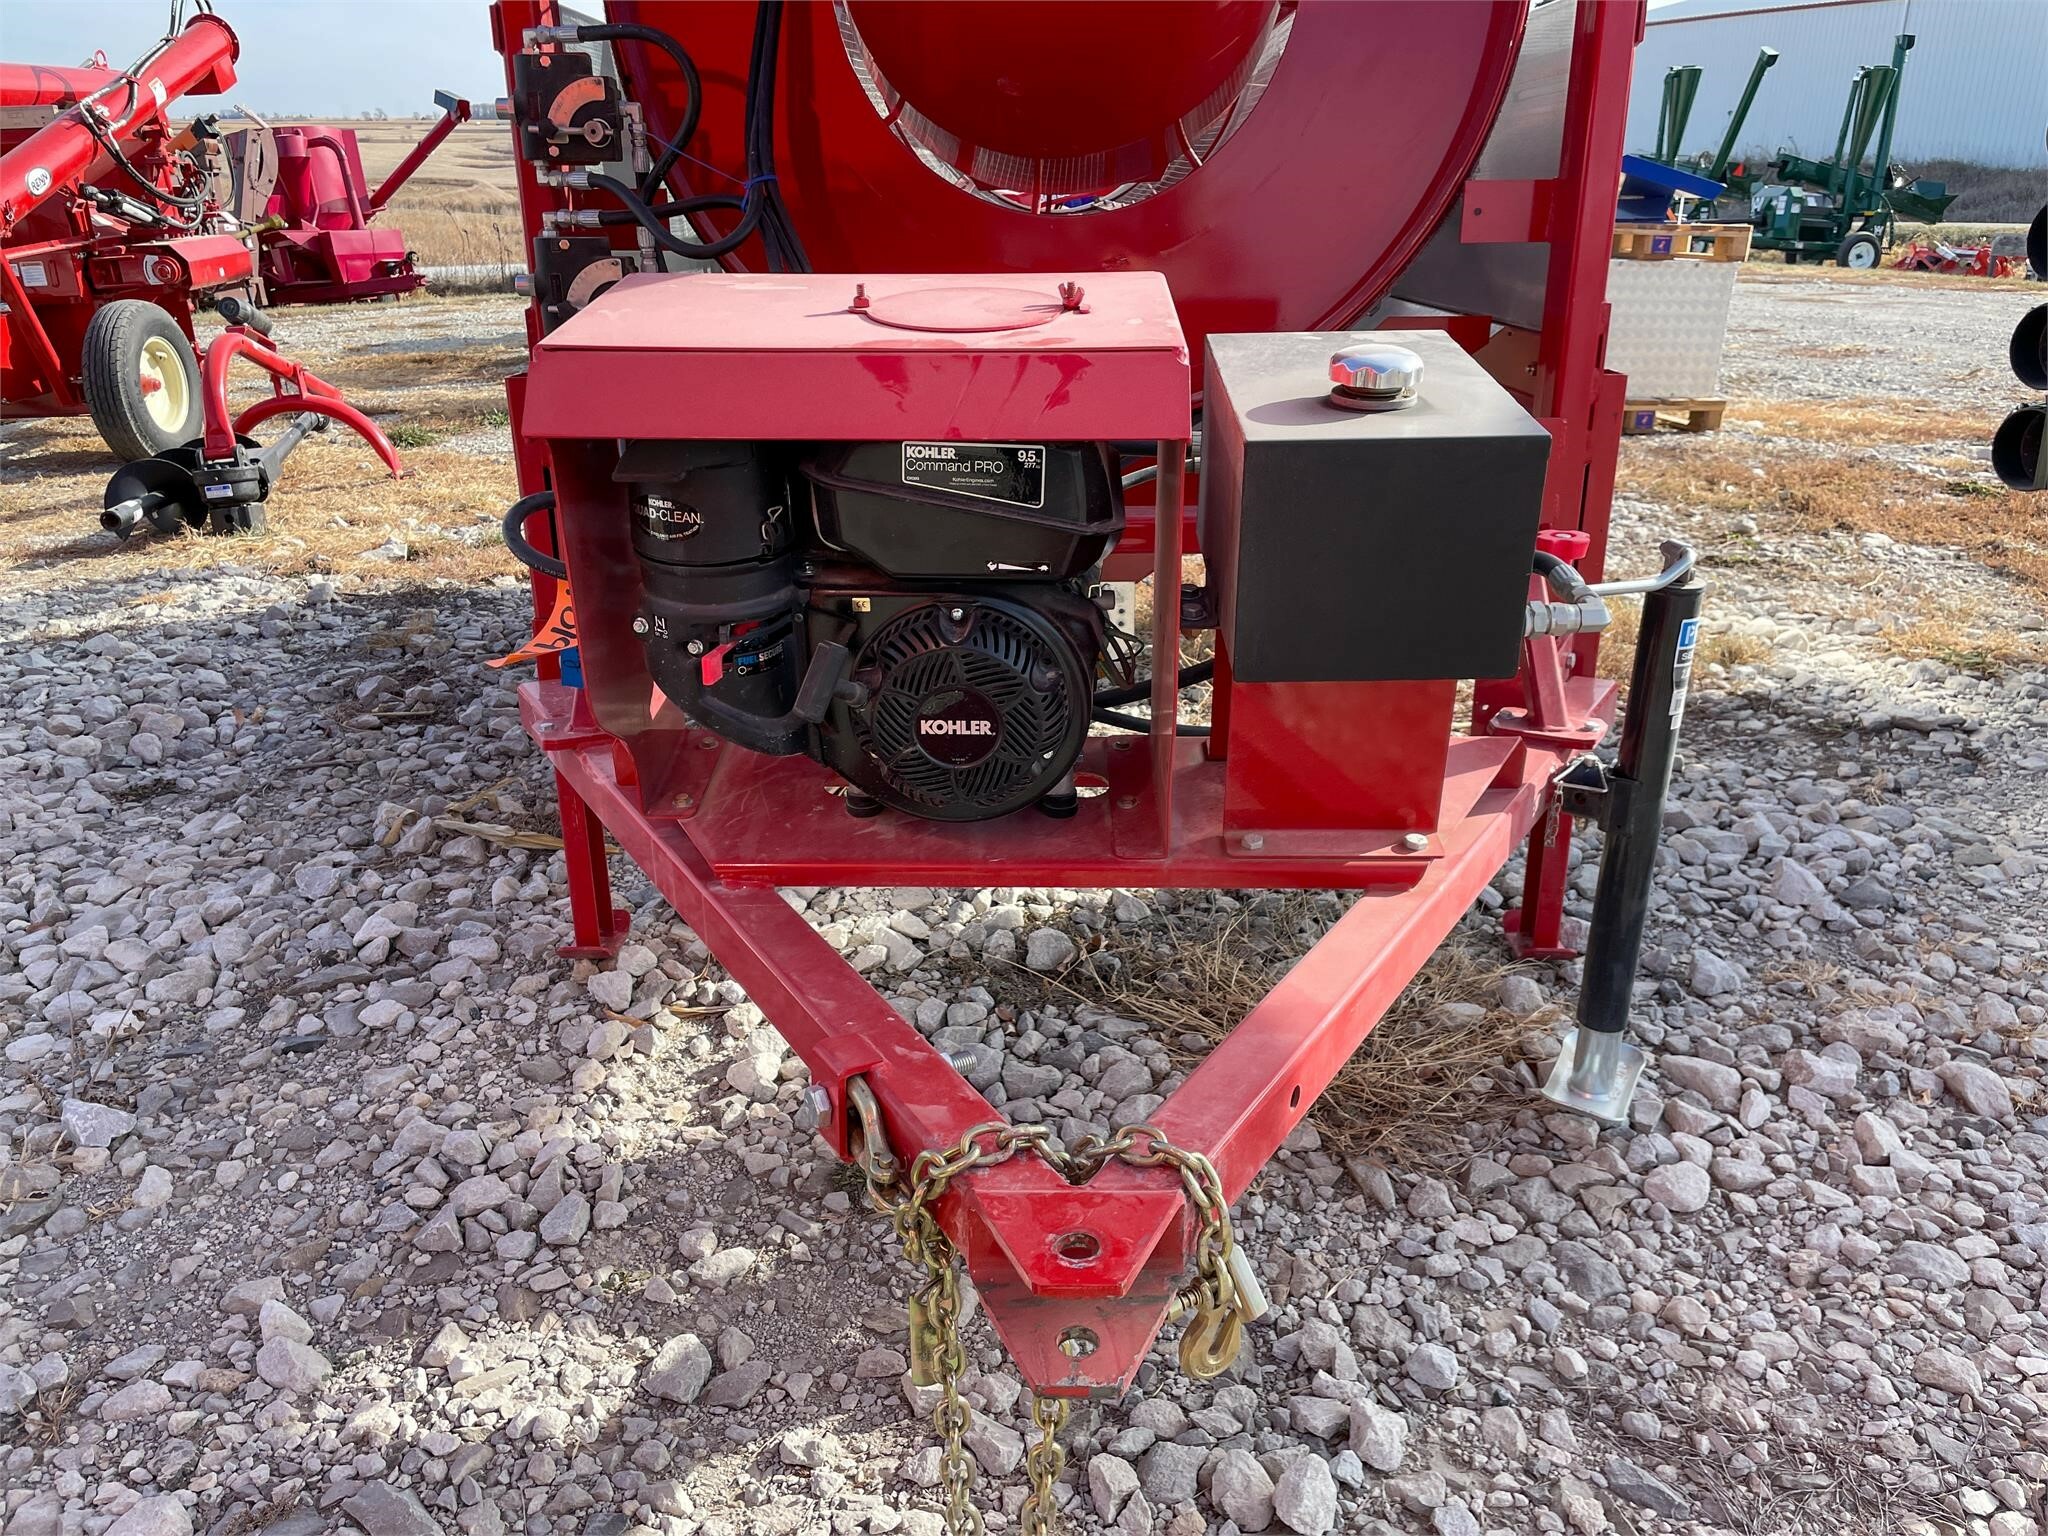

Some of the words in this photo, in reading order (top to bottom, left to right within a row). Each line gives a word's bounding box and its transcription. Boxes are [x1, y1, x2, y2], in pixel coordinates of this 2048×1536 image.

[906, 446, 957, 460] KOHLER
[1017, 450, 1037, 463] 9.5
[905, 458, 971, 473] Command
[974, 460, 1004, 474] PRO
[648, 497, 675, 509] KOHLER
[633, 503, 702, 524] UAD-CLEAN
[920, 719, 993, 735] KOHLER
